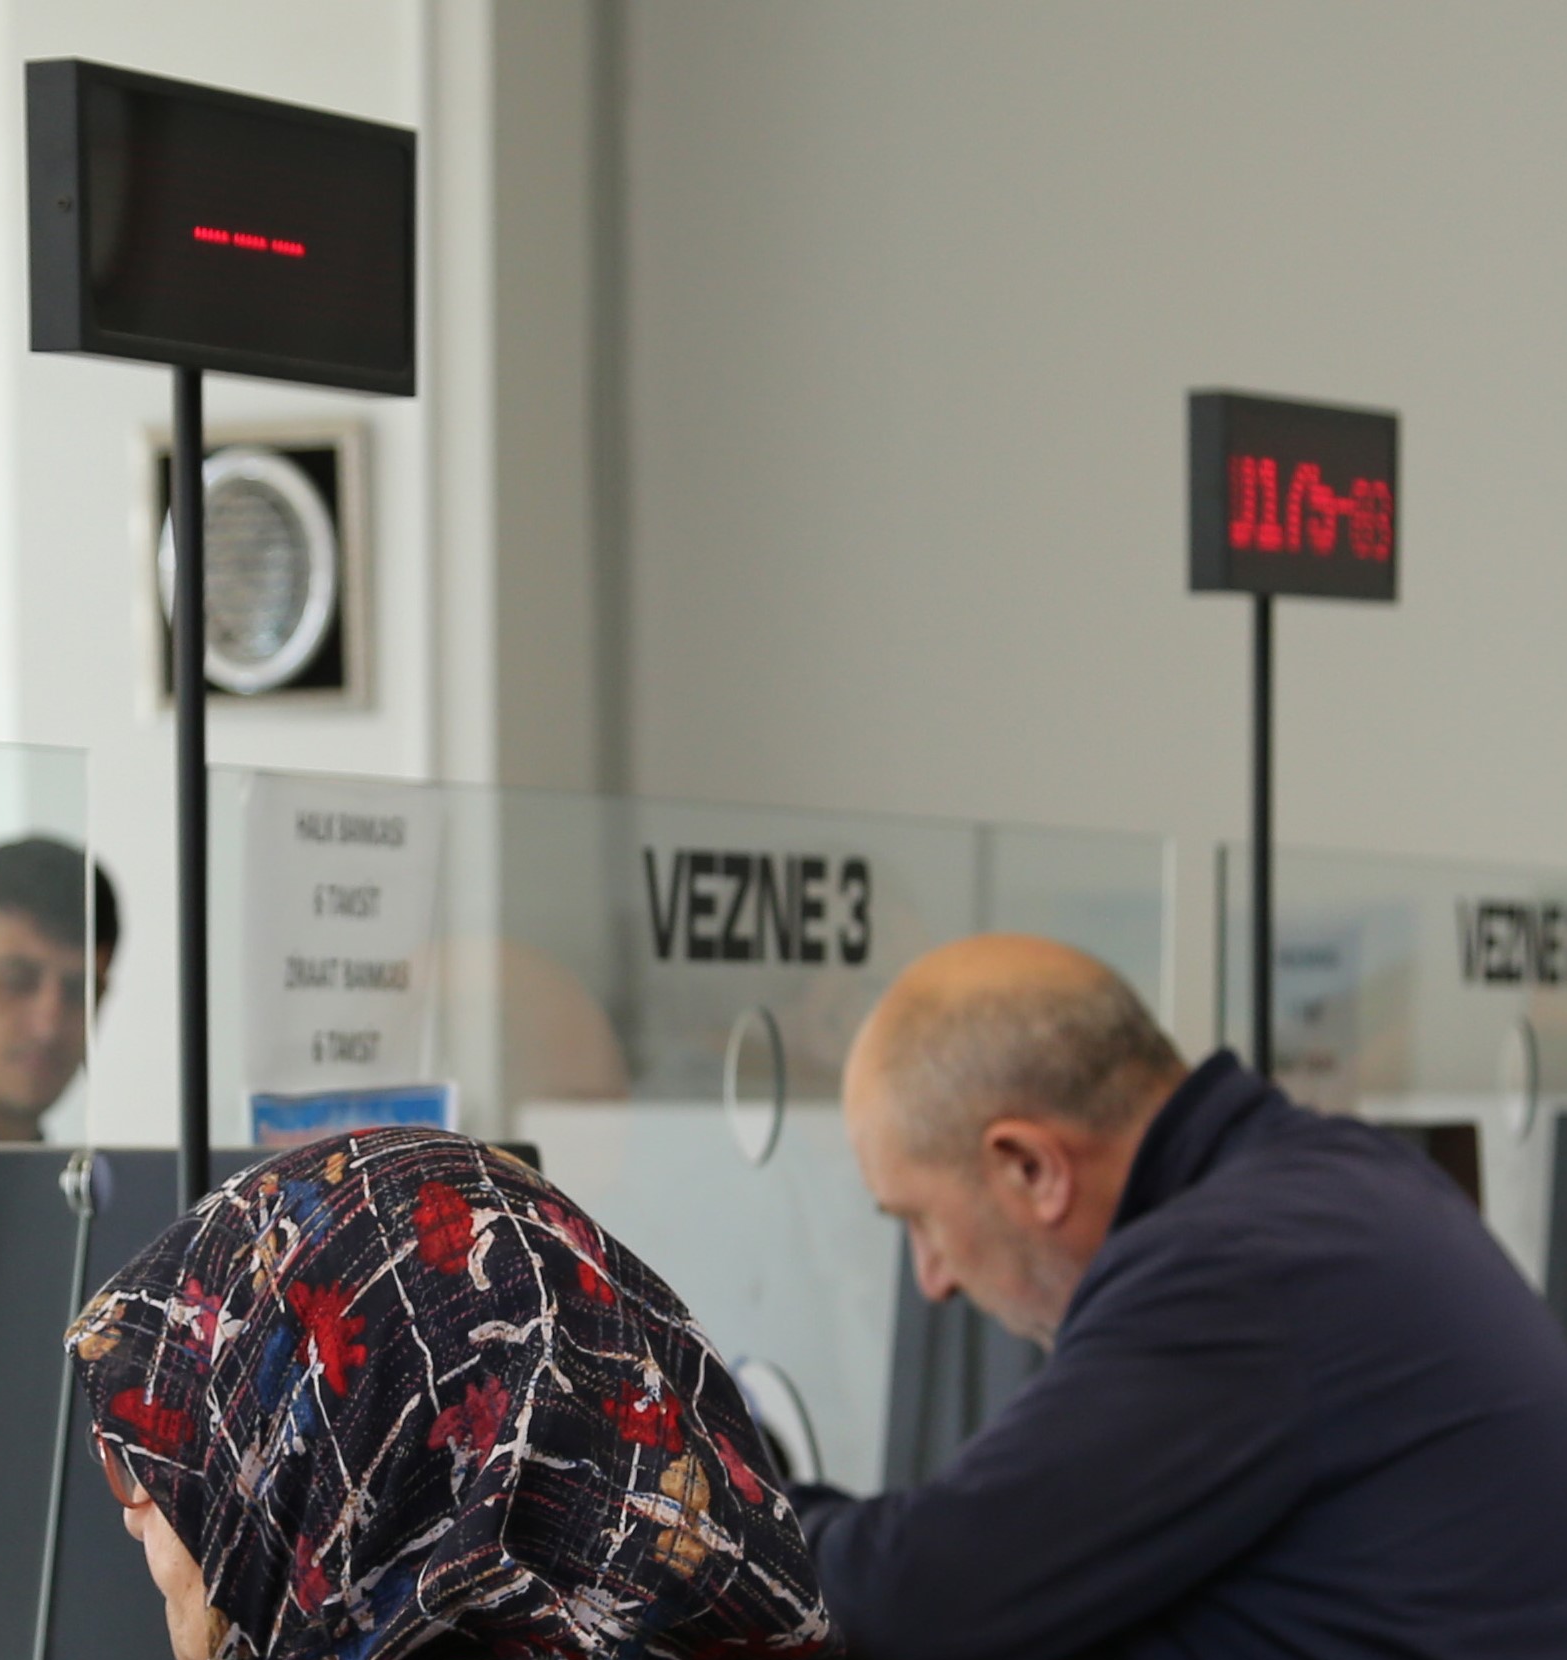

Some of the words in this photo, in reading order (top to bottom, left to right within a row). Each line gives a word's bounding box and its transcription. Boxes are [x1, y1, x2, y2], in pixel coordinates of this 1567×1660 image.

[641, 846, 827, 964] VEZNE
[838, 854, 872, 966] 3
[1453, 896, 1560, 984] VEZNE
